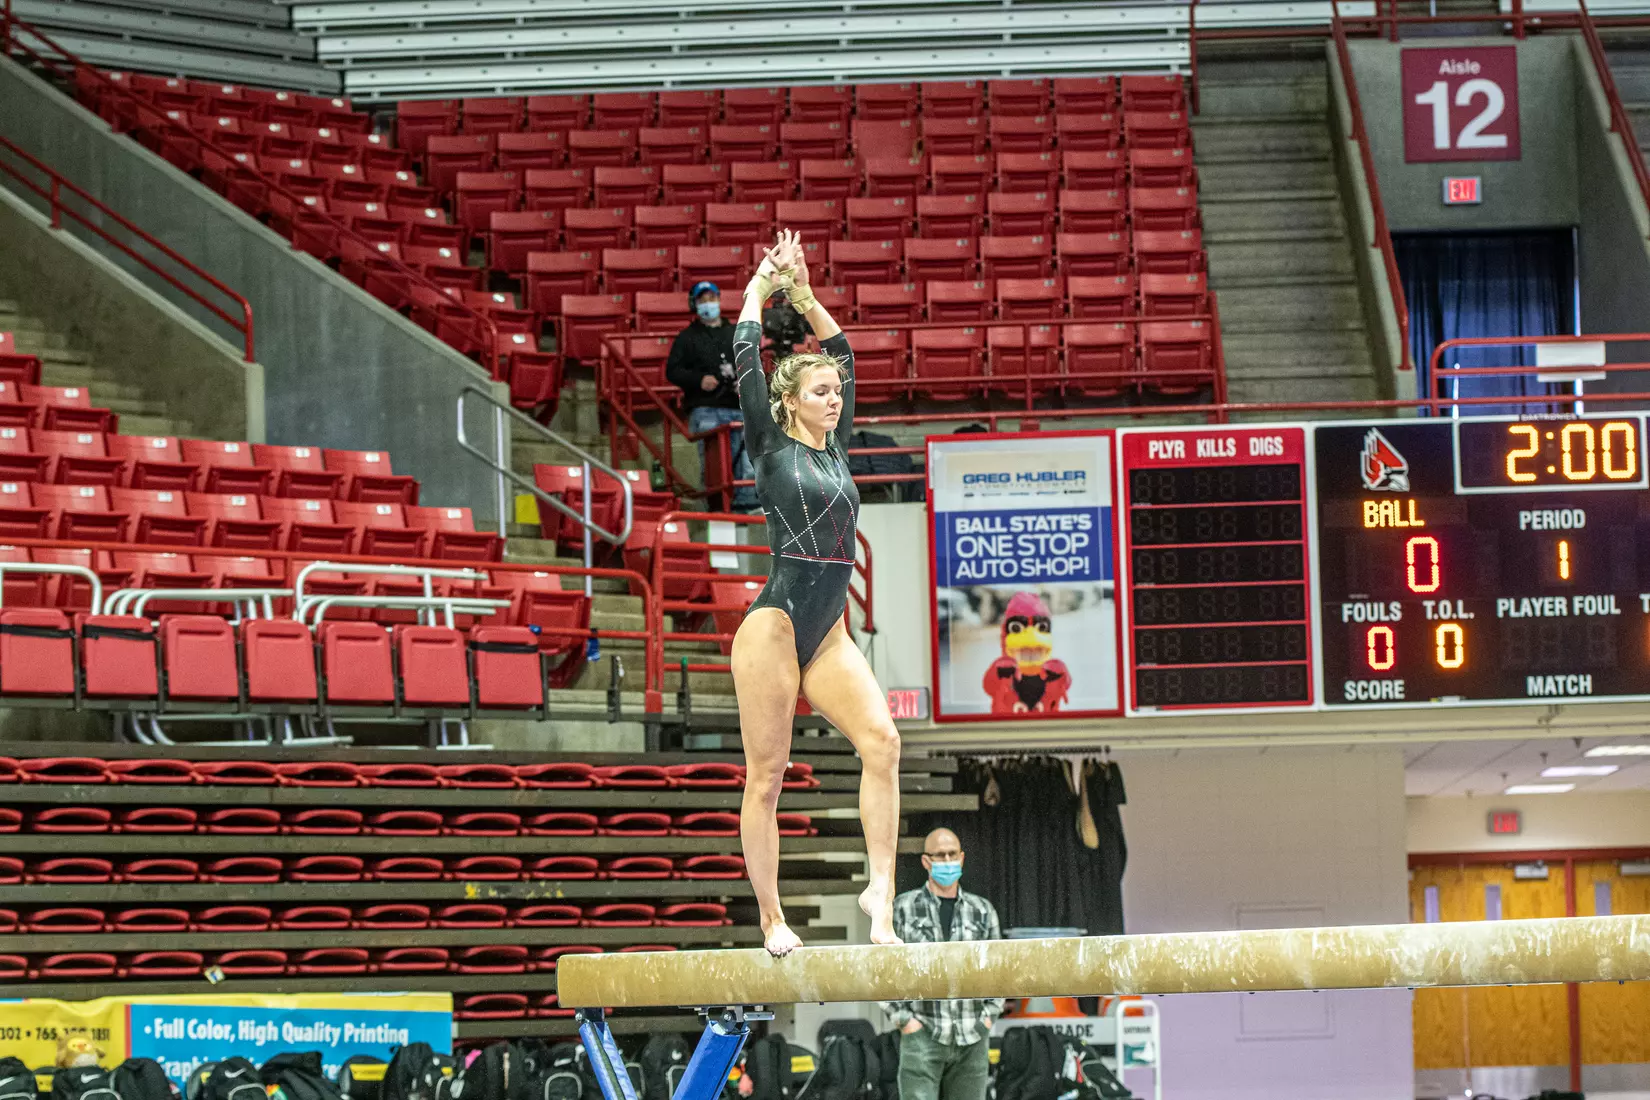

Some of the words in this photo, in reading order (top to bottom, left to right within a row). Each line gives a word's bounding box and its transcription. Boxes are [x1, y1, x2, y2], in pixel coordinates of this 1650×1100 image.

[1439, 58, 1481, 75] Aisle
[1415, 78, 1508, 150] 12
[1149, 439, 1186, 459] PLYR
[1196, 437, 1237, 458] KILLS
[1249, 435, 1284, 456] DIGS
[1506, 422, 1636, 482] 2:00
[963, 472, 1011, 484] GREG
[1016, 470, 1086, 482] HUBLER
[955, 516, 1008, 534] BALL
[1010, 513, 1092, 533] STATE'S
[1363, 499, 1425, 528] BALL
[1519, 508, 1586, 530] PERIOD
[955, 534, 1014, 558] ONE
[1017, 532, 1089, 556] STOP
[955, 558, 1018, 579] AUTO
[1020, 556, 1090, 578] SHOP!
[1406, 536, 1440, 593] 0
[1559, 540, 1569, 579] 1
[1341, 600, 1403, 623] FOULS
[1423, 600, 1475, 620] T.O.L.
[1496, 597, 1568, 618] PLAYER
[1573, 594, 1621, 616] FOUL
[1367, 626, 1394, 670] 0
[1435, 623, 1464, 669] 0
[1344, 679, 1405, 701] SCORE
[1526, 674, 1592, 696] MATCH
[888, 690, 920, 719] EXIT
[154, 1017, 185, 1040] Full
[187, 1017, 236, 1043] Color,
[237, 1019, 279, 1047] High
[281, 1020, 342, 1048] Quality
[343, 1022, 409, 1048] Printing
